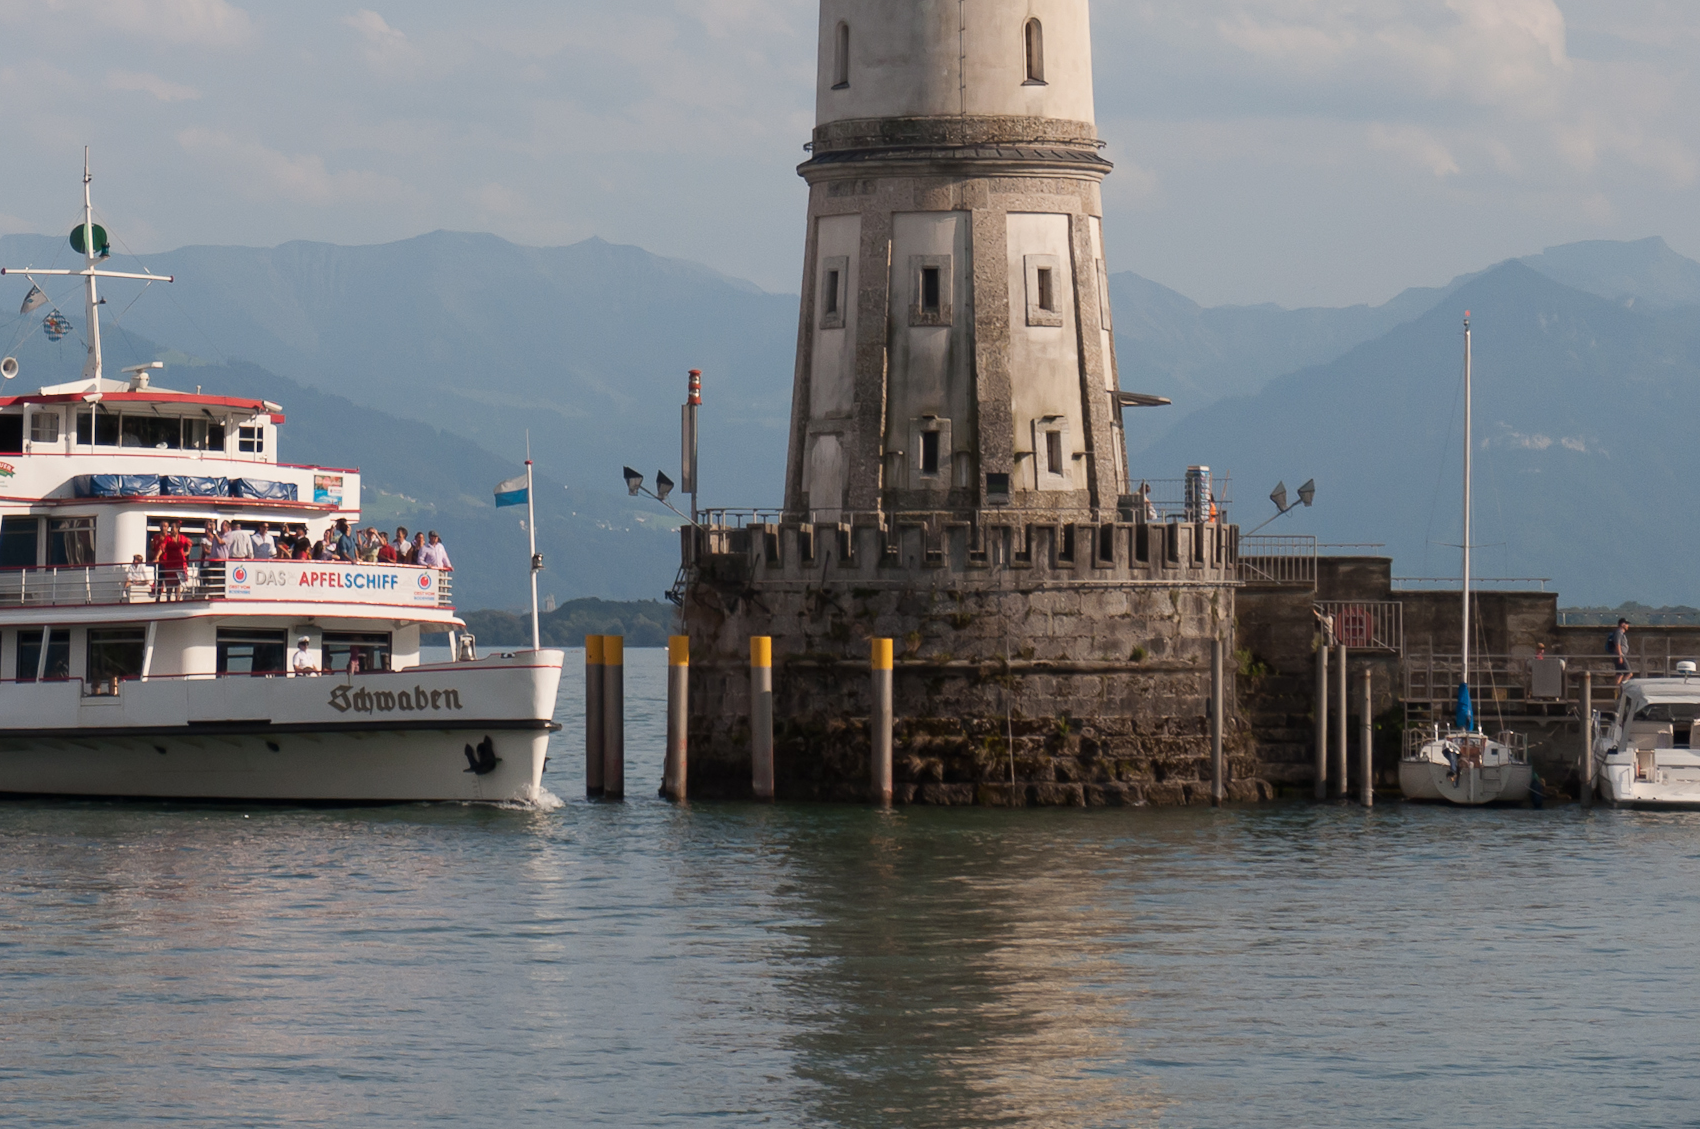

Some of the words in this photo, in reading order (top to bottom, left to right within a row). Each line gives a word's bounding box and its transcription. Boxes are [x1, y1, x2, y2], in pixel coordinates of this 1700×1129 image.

[255, 570, 287, 587] DAS
[298, 570, 399, 590] APFELSCHIFF
[327, 684, 463, 715] Schwaben
